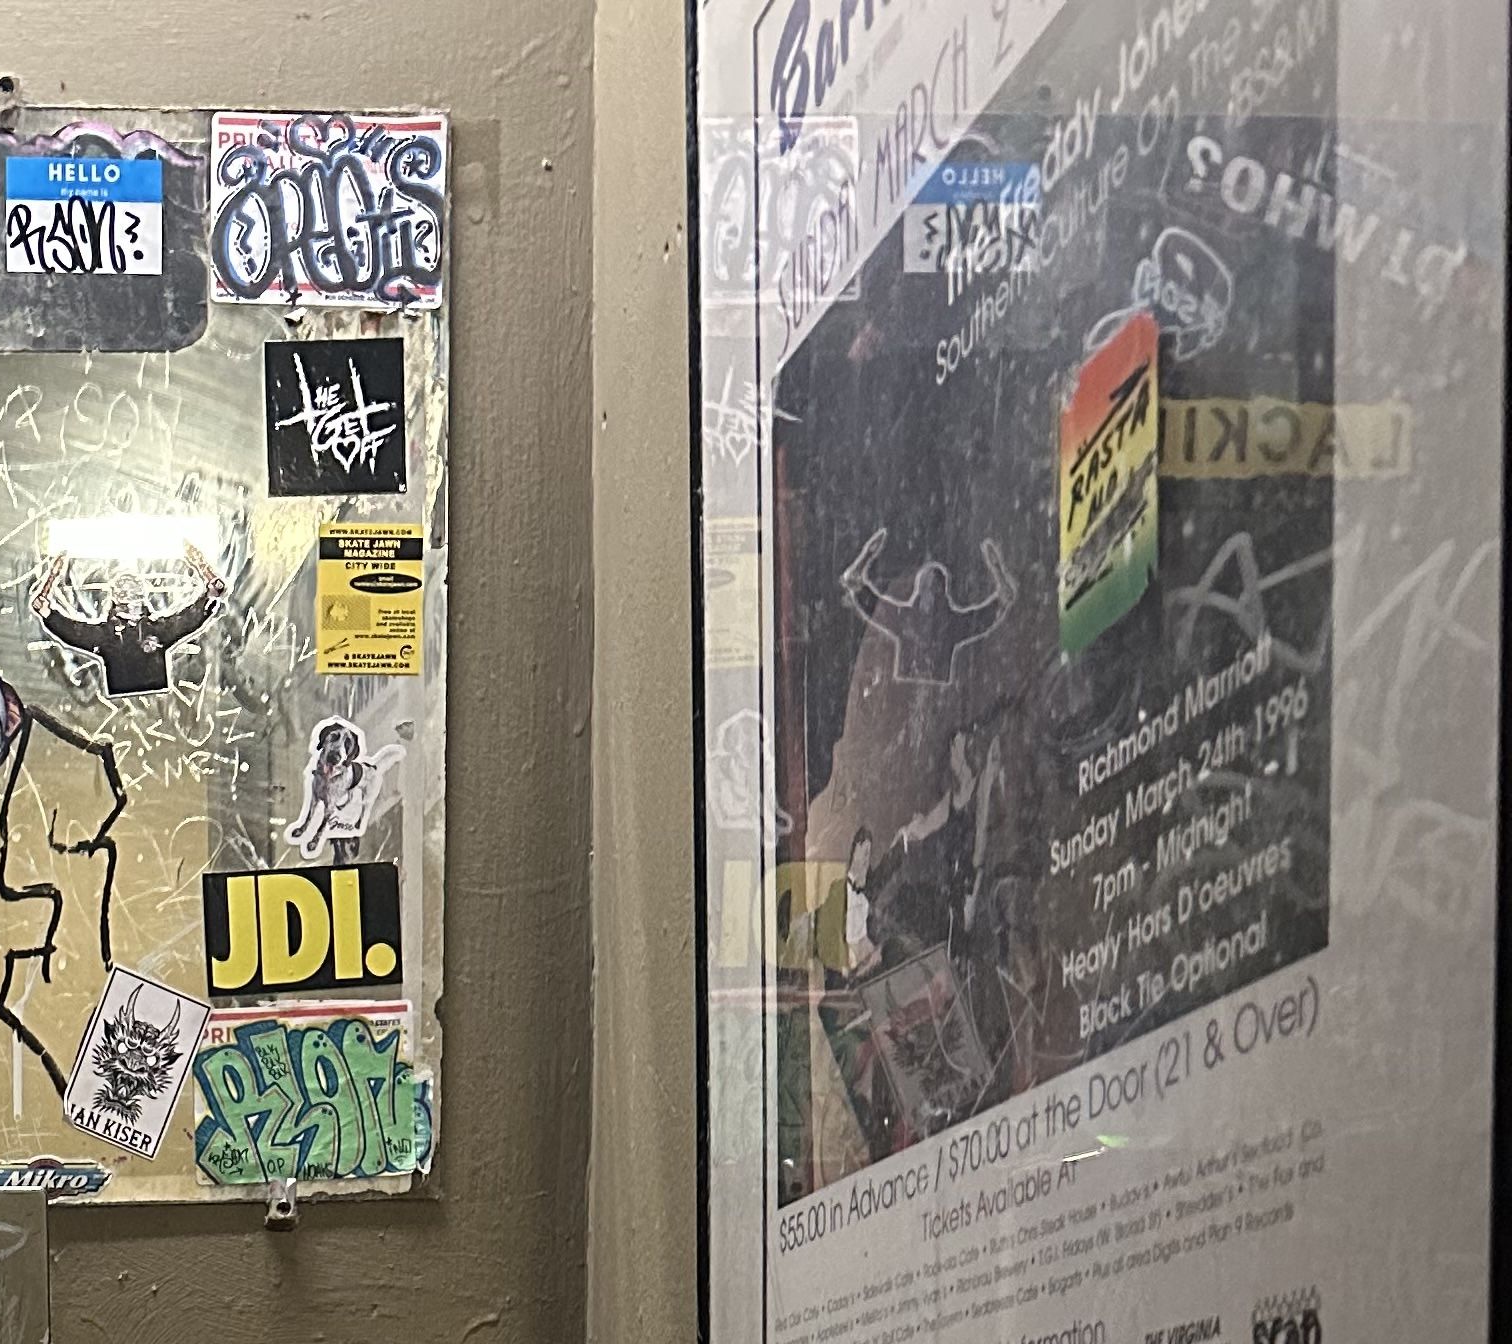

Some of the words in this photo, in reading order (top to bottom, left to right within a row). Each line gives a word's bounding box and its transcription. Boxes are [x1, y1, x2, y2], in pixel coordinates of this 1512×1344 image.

[48, 162, 121, 184] HELLO
[936, 252, 1038, 387] Southern
[1039, 144, 1132, 267] Culture
[338, 539, 371, 549] SKATE
[372, 539, 401, 549] JAWN
[343, 549, 395, 558] MAGAZINE
[345, 561, 369, 570] CITY
[371, 562, 396, 570] WIDE
[1078, 693, 1181, 797] Richmond
[1185, 627, 1272, 725] Marriott
[1050, 808, 1120, 876] Sunday
[1125, 756, 1193, 830] March
[1197, 723, 1245, 779] 24th
[1255, 676, 1309, 743] 1996
[1092, 856, 1136, 912] 7pm
[1156, 781, 1252, 873] Midnight
[210, 867, 397, 990] JDI.
[1061, 931, 1122, 989] Heavy
[1128, 904, 1172, 951] Hors
[1177, 836, 1292, 925] D'oeuvres
[1079, 982, 1132, 1040] Black
[1136, 970, 1166, 1011] Tie
[1170, 908, 1268, 993] Optional
[100, 1110, 154, 1153] KISER
[778, 1200, 827, 1257] $55.00
[829, 1198, 844, 1233] in
[847, 1163, 930, 1232] Advance
[934, 1146, 943, 1193] /
[949, 1116, 1011, 1182] $70.00
[1016, 1105, 1039, 1152] at
[1044, 1093, 1082, 1139] the
[1089, 1060, 1148, 1121] Door
[1154, 1030, 1191, 1101] (21
[1203, 1018, 1225, 1070] &
[1233, 975, 1320, 1056] Over)
[3, 1169, 88, 1189] Mikro
[920, 1199, 973, 1242] Tickets
[975, 1166, 1053, 1224] Available
